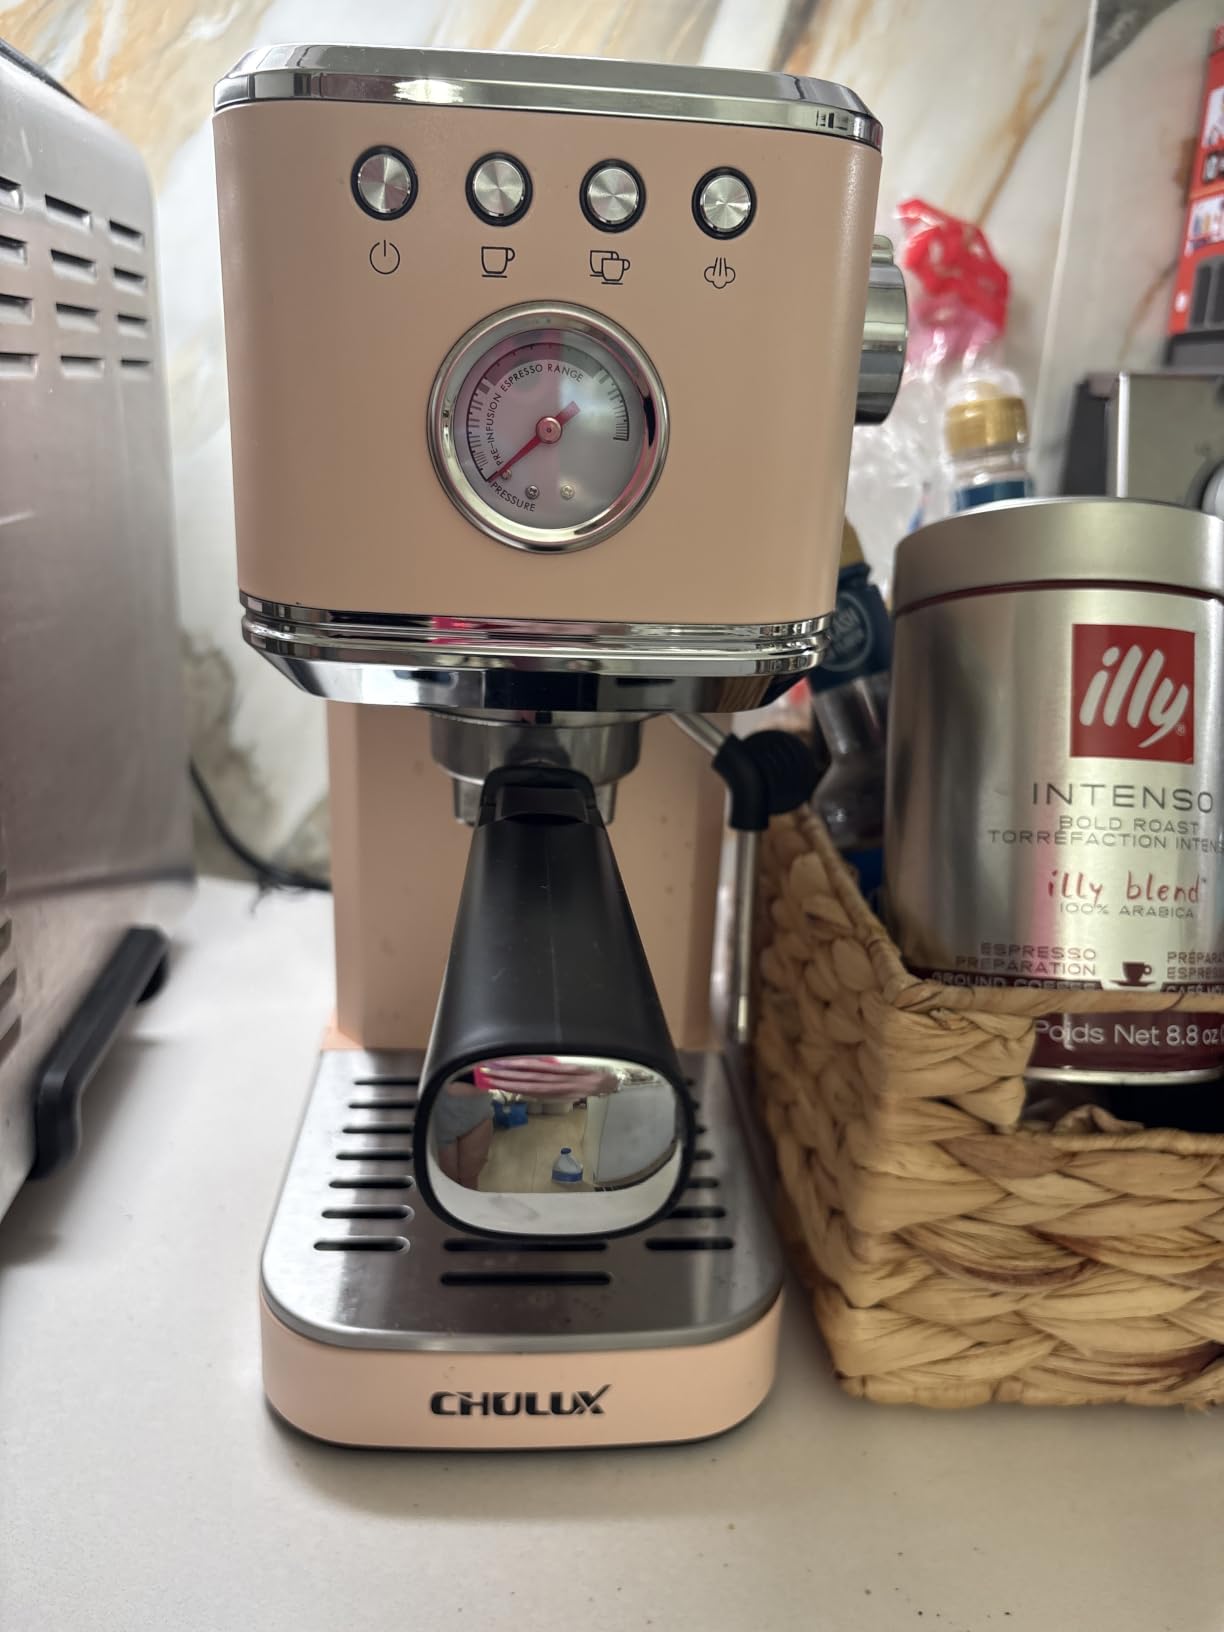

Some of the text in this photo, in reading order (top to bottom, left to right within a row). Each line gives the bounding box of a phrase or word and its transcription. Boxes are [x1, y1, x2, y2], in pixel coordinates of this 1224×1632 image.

[486, 363, 584, 466] PRE-INFUSION ESPRESSO RANGE
[491, 481, 536, 512] PRESSURE
[1079, 644, 1189, 748] illy
[1032, 783, 1214, 813] INTENSO
[1059, 815, 1199, 835] BOLD ROAST
[1047, 870, 1103, 905] illy
[1059, 902, 1194, 919] 100% ARABICA
[954, 955, 1096, 977] PREPARATION
[980, 942, 1097, 961] ESPRESSO
[1113, 1023, 1160, 1046] Net
[1165, 1024, 1199, 1046] 8.8
[430, 1384, 612, 1416] CHULUX
